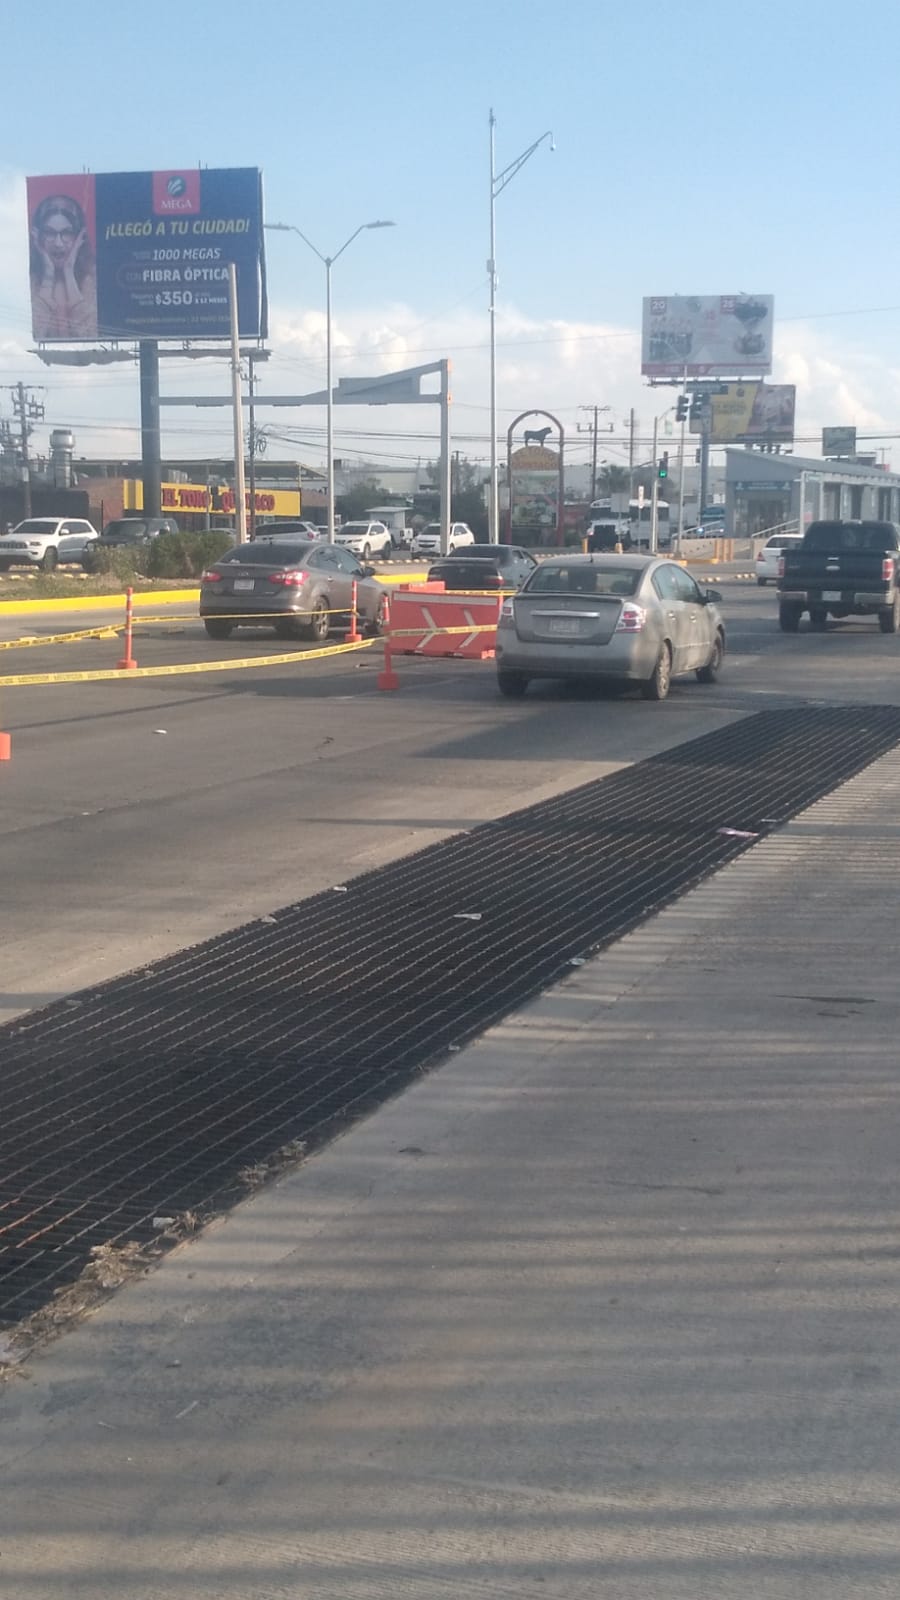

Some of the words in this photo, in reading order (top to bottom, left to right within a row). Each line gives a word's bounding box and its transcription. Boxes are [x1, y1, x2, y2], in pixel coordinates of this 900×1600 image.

[160, 199, 193, 209] MEGA
[105, 219, 153, 240] ¡LLEGÓ
[155, 222, 166, 236] A
[170, 220, 188, 235] TU
[192, 218, 250, 235] CIUDAD!
[152, 249, 180, 261] 1000
[182, 247, 222, 260] MEGAS
[142, 268, 181, 282] FIBRA
[183, 266, 230, 281] ÓPTICA
[155, 290, 193, 306] $350
[162, 488, 178, 506] EL
[178, 489, 211, 507] TORO
